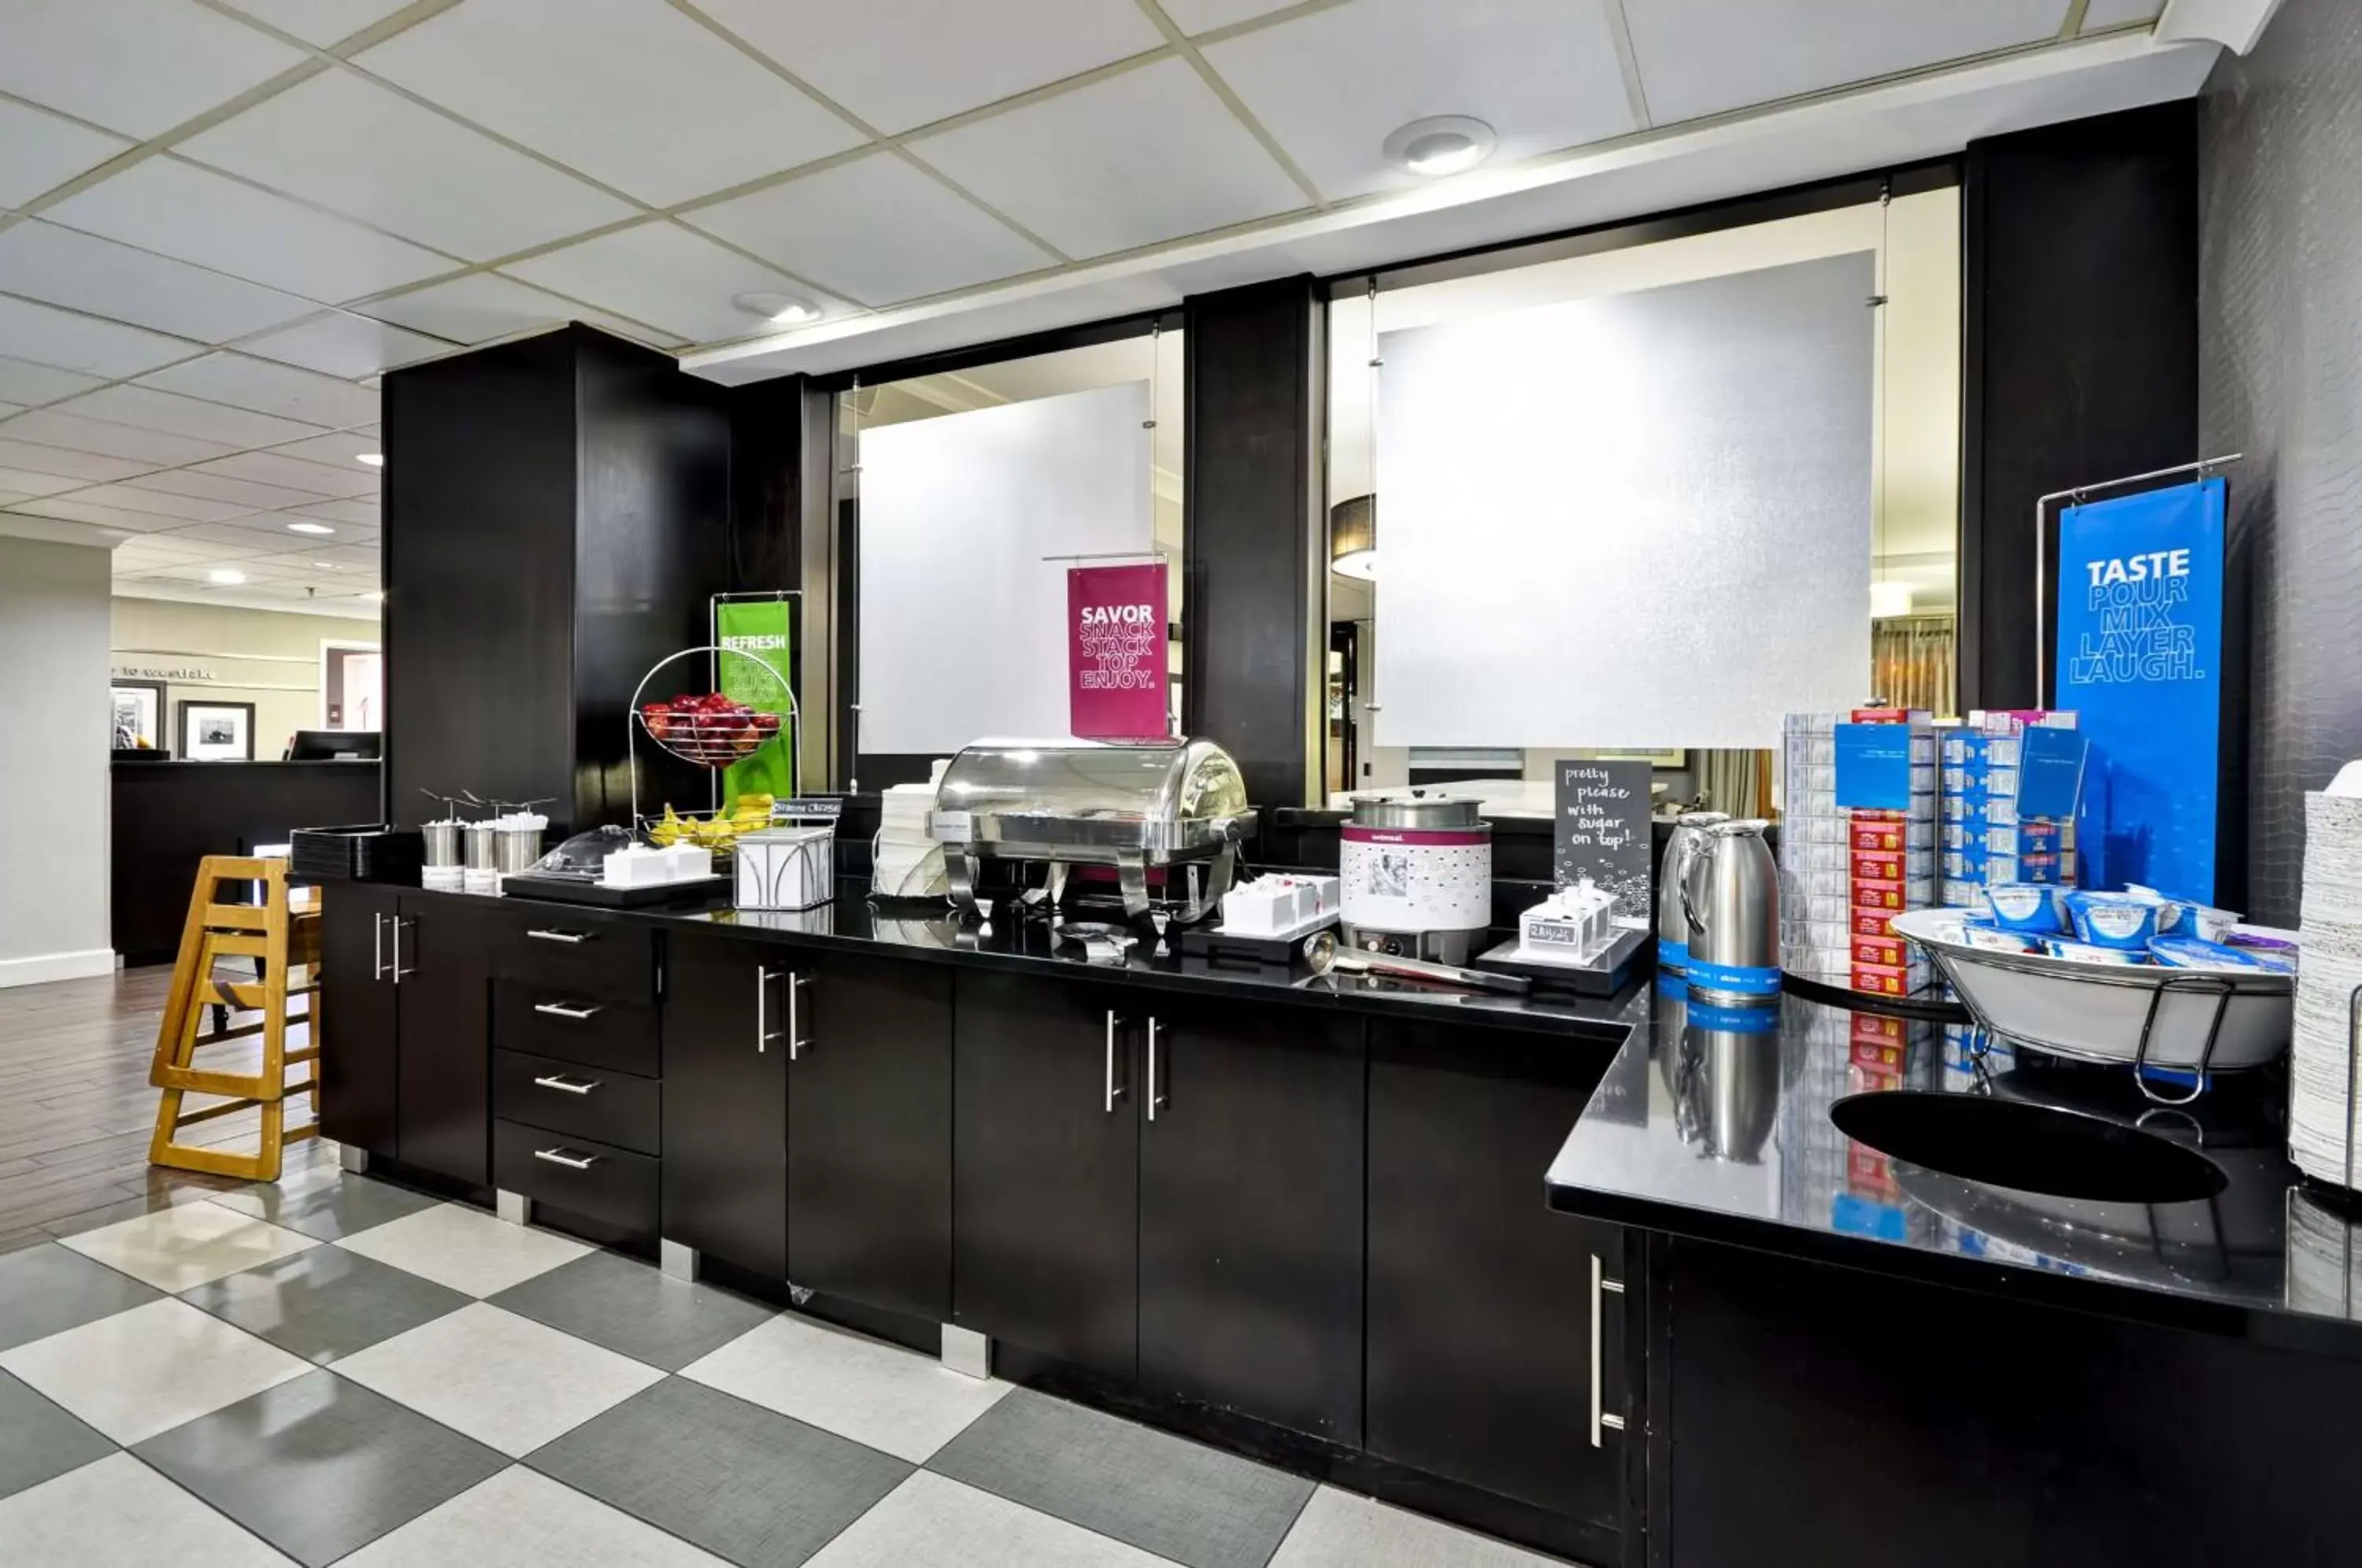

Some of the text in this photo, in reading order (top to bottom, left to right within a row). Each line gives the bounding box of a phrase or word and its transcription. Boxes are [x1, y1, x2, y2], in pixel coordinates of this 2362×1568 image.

[2086, 549, 2190, 586] TASTE
[2088, 575, 2189, 612] POUR
[1081, 605, 1154, 624] SAVOR
[2100, 600, 2173, 634] MIX
[1079, 620, 1156, 641] SNACK
[721, 634, 786, 650] REFRESH
[1082, 637, 1153, 657] STACK
[2080, 624, 2195, 660] LAYER
[1095, 653, 1139, 671] TOP
[2068, 651, 2205, 684] LAUGH.
[1079, 670, 1156, 689] ENJOY.
[1564, 767, 1609, 786] pretty
[1577, 786, 1631, 803] please
[1567, 804, 1605, 816] with
[1578, 817, 1625, 835] sugar
[1572, 829, 1632, 851] on top!
